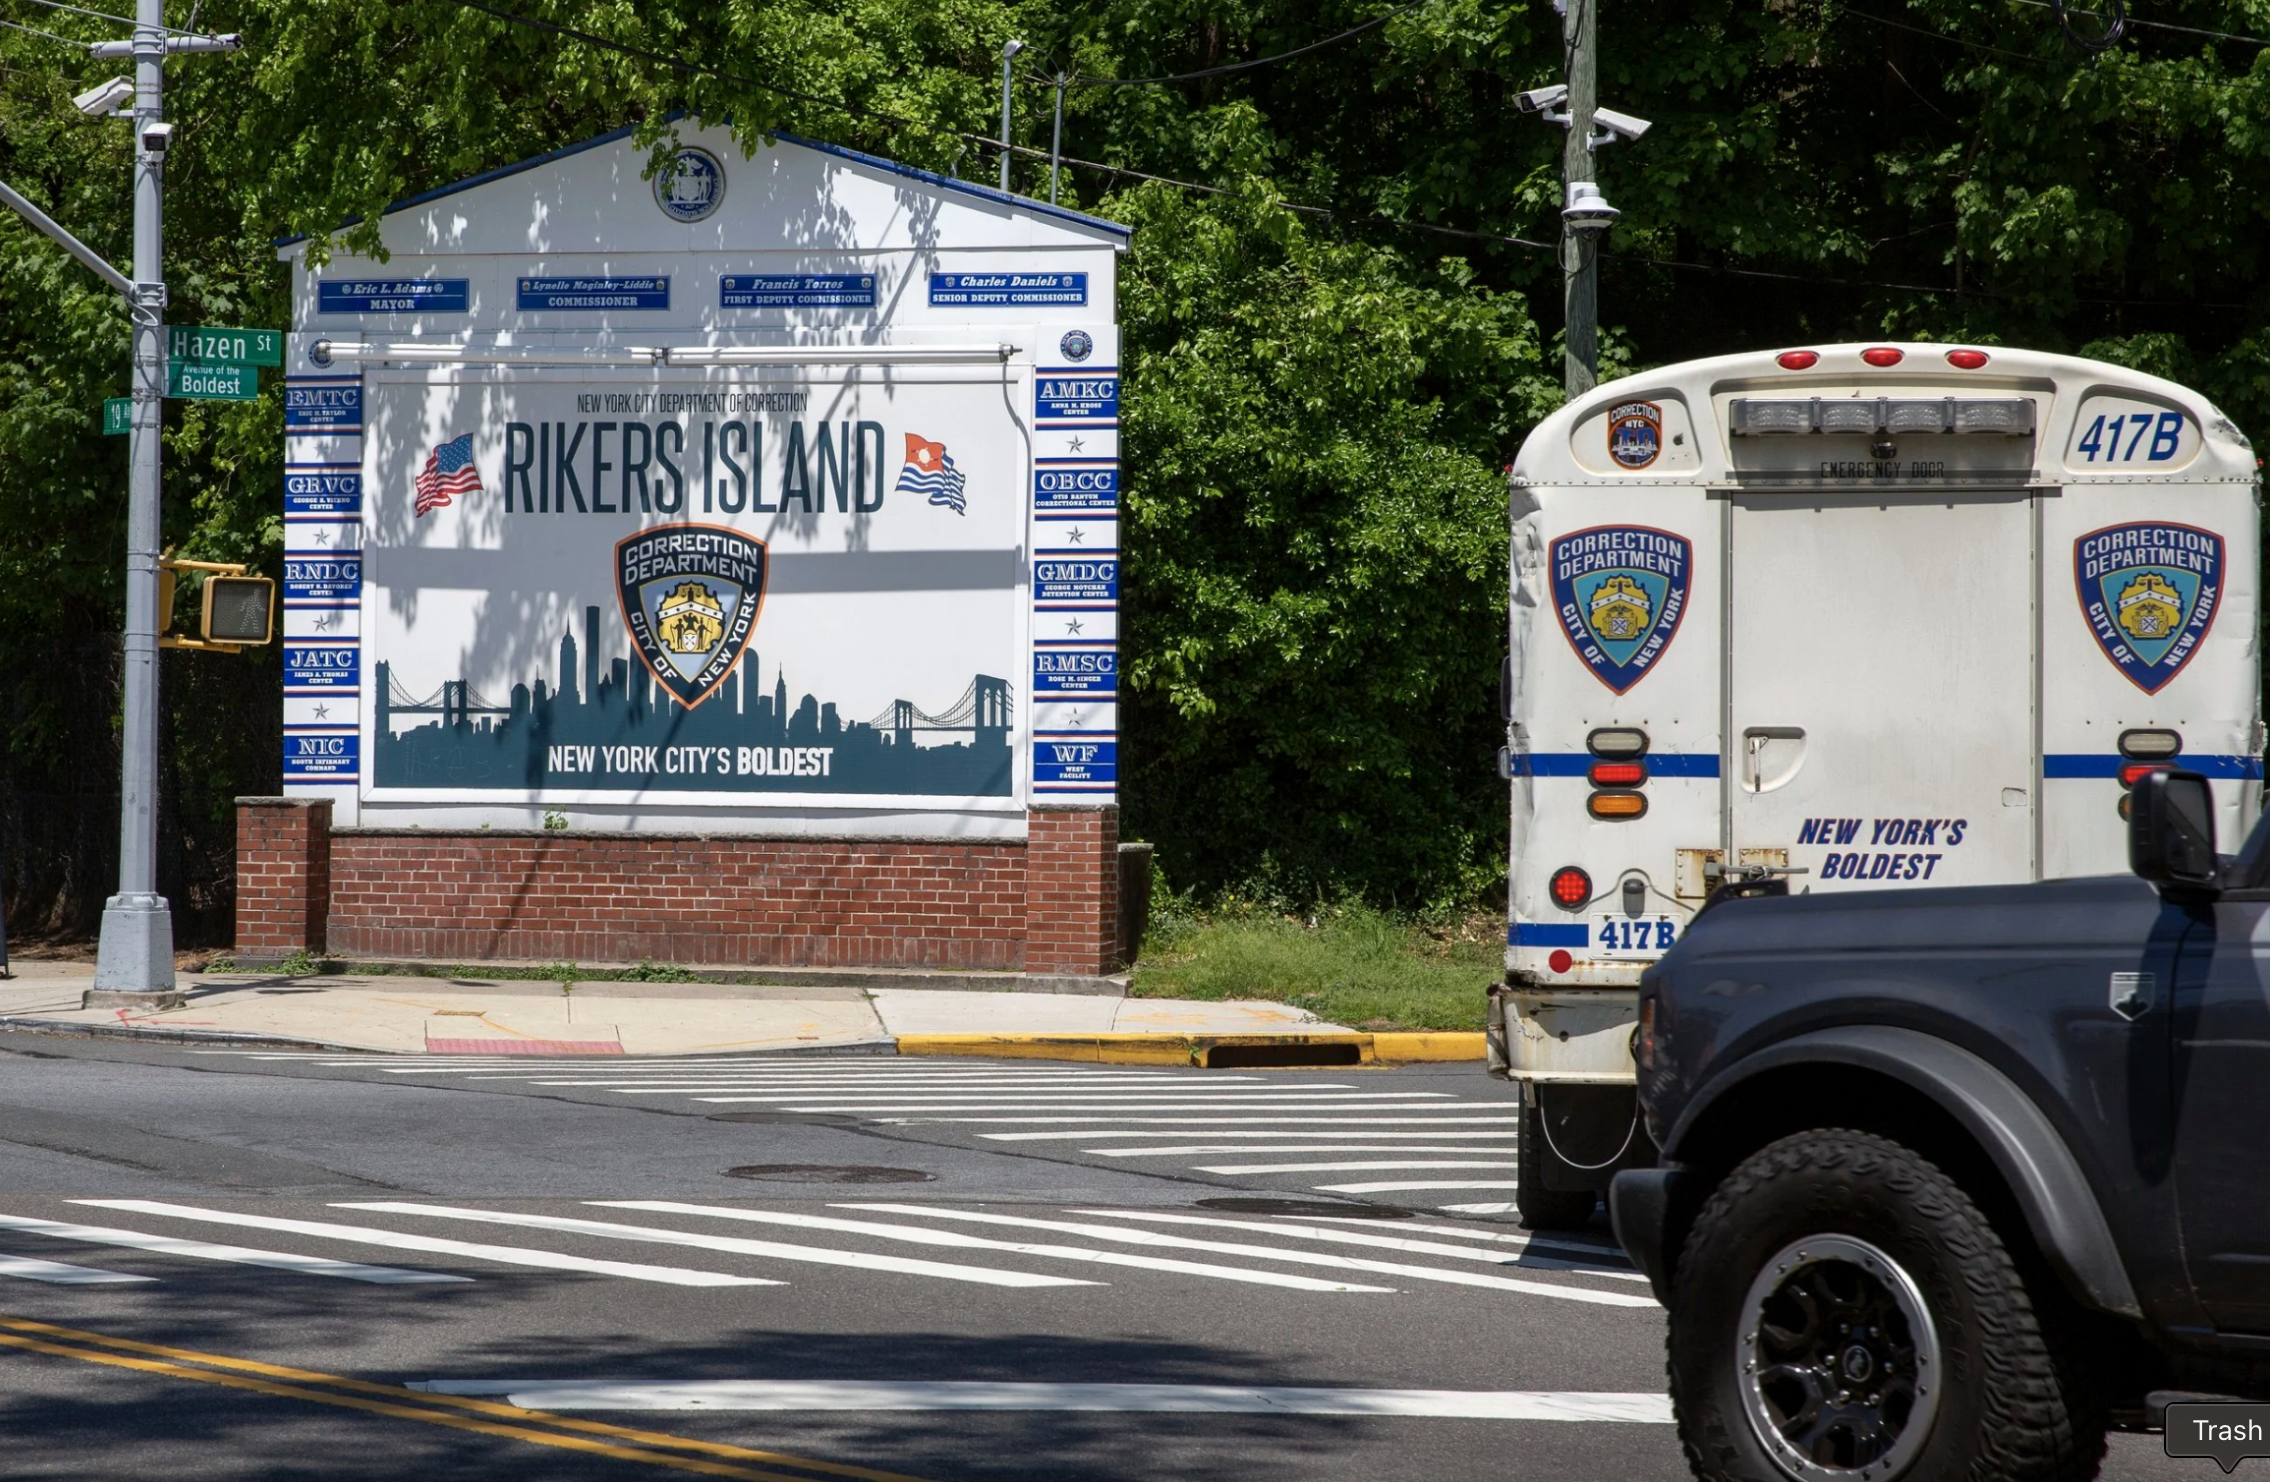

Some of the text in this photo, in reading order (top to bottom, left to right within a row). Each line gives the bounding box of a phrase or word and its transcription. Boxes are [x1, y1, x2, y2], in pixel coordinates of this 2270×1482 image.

[353, 284, 432, 294] Eric L. Adams
[533, 281, 655, 292] Lynelle Maginley-Liddie
[752, 279, 843, 290] Francis Torres
[961, 276, 1058, 287] Charles Daniels
[371, 300, 415, 310] MAYOR
[549, 297, 638, 306] COMMISSIONER
[724, 295, 872, 304] FIRST DEPUTY COMMISSIONER
[933, 294, 1083, 302] SENIOR DEPUTY COMMISSIONER
[174, 332, 271, 359] Hazen St
[183, 365, 240, 375] Avenue of the
[182, 375, 240, 394] Boldest
[1040, 381, 1114, 399] AMKC
[288, 389, 357, 407] EMTC
[578, 393, 808, 413] NEW YORK CITY DEPARTMENT OF CORRECTION
[112, 404, 120, 429] 19
[1611, 404, 1659, 423] CORRECTION
[1626, 420, 1644, 428] NYC
[2078, 412, 2184, 462] 417B
[505, 421, 885, 514] RIKERS ISLAND
[1820, 462, 1944, 479] EMERGENCY DOOR
[288, 477, 355, 494] GRVC
[1040, 472, 1112, 490] OBCC
[625, 535, 758, 566] CORRECTION
[1558, 533, 1682, 560] CORRECTION
[2084, 529, 2214, 558] CORRECTION
[285, 563, 358, 580] RNDC
[625, 554, 758, 586] DEPARTMENT
[1038, 564, 1114, 581] GMDC
[1560, 550, 1681, 580] DEPARTMENT
[2086, 548, 2214, 579] DEPARTMENT
[1563, 603, 1605, 665] CITY OF
[1633, 588, 1684, 668] NEW YORK
[2089, 602, 2134, 665] CITY OF
[2164, 585, 2216, 667] NEW YORK
[631, 611, 677, 679] CITY OF
[698, 592, 756, 687] NEW YORK
[291, 650, 352, 667] JATC
[1037, 654, 1113, 672] RMSC
[299, 738, 344, 755] NIC
[1052, 745, 1098, 762] WF
[548, 746, 834, 776] NEW YORK CITY'S BOLDEST
[1797, 818, 1968, 845] NEW YORK'S
[1820, 853, 1943, 880] BOLDEST
[1599, 922, 1676, 950] 417B
